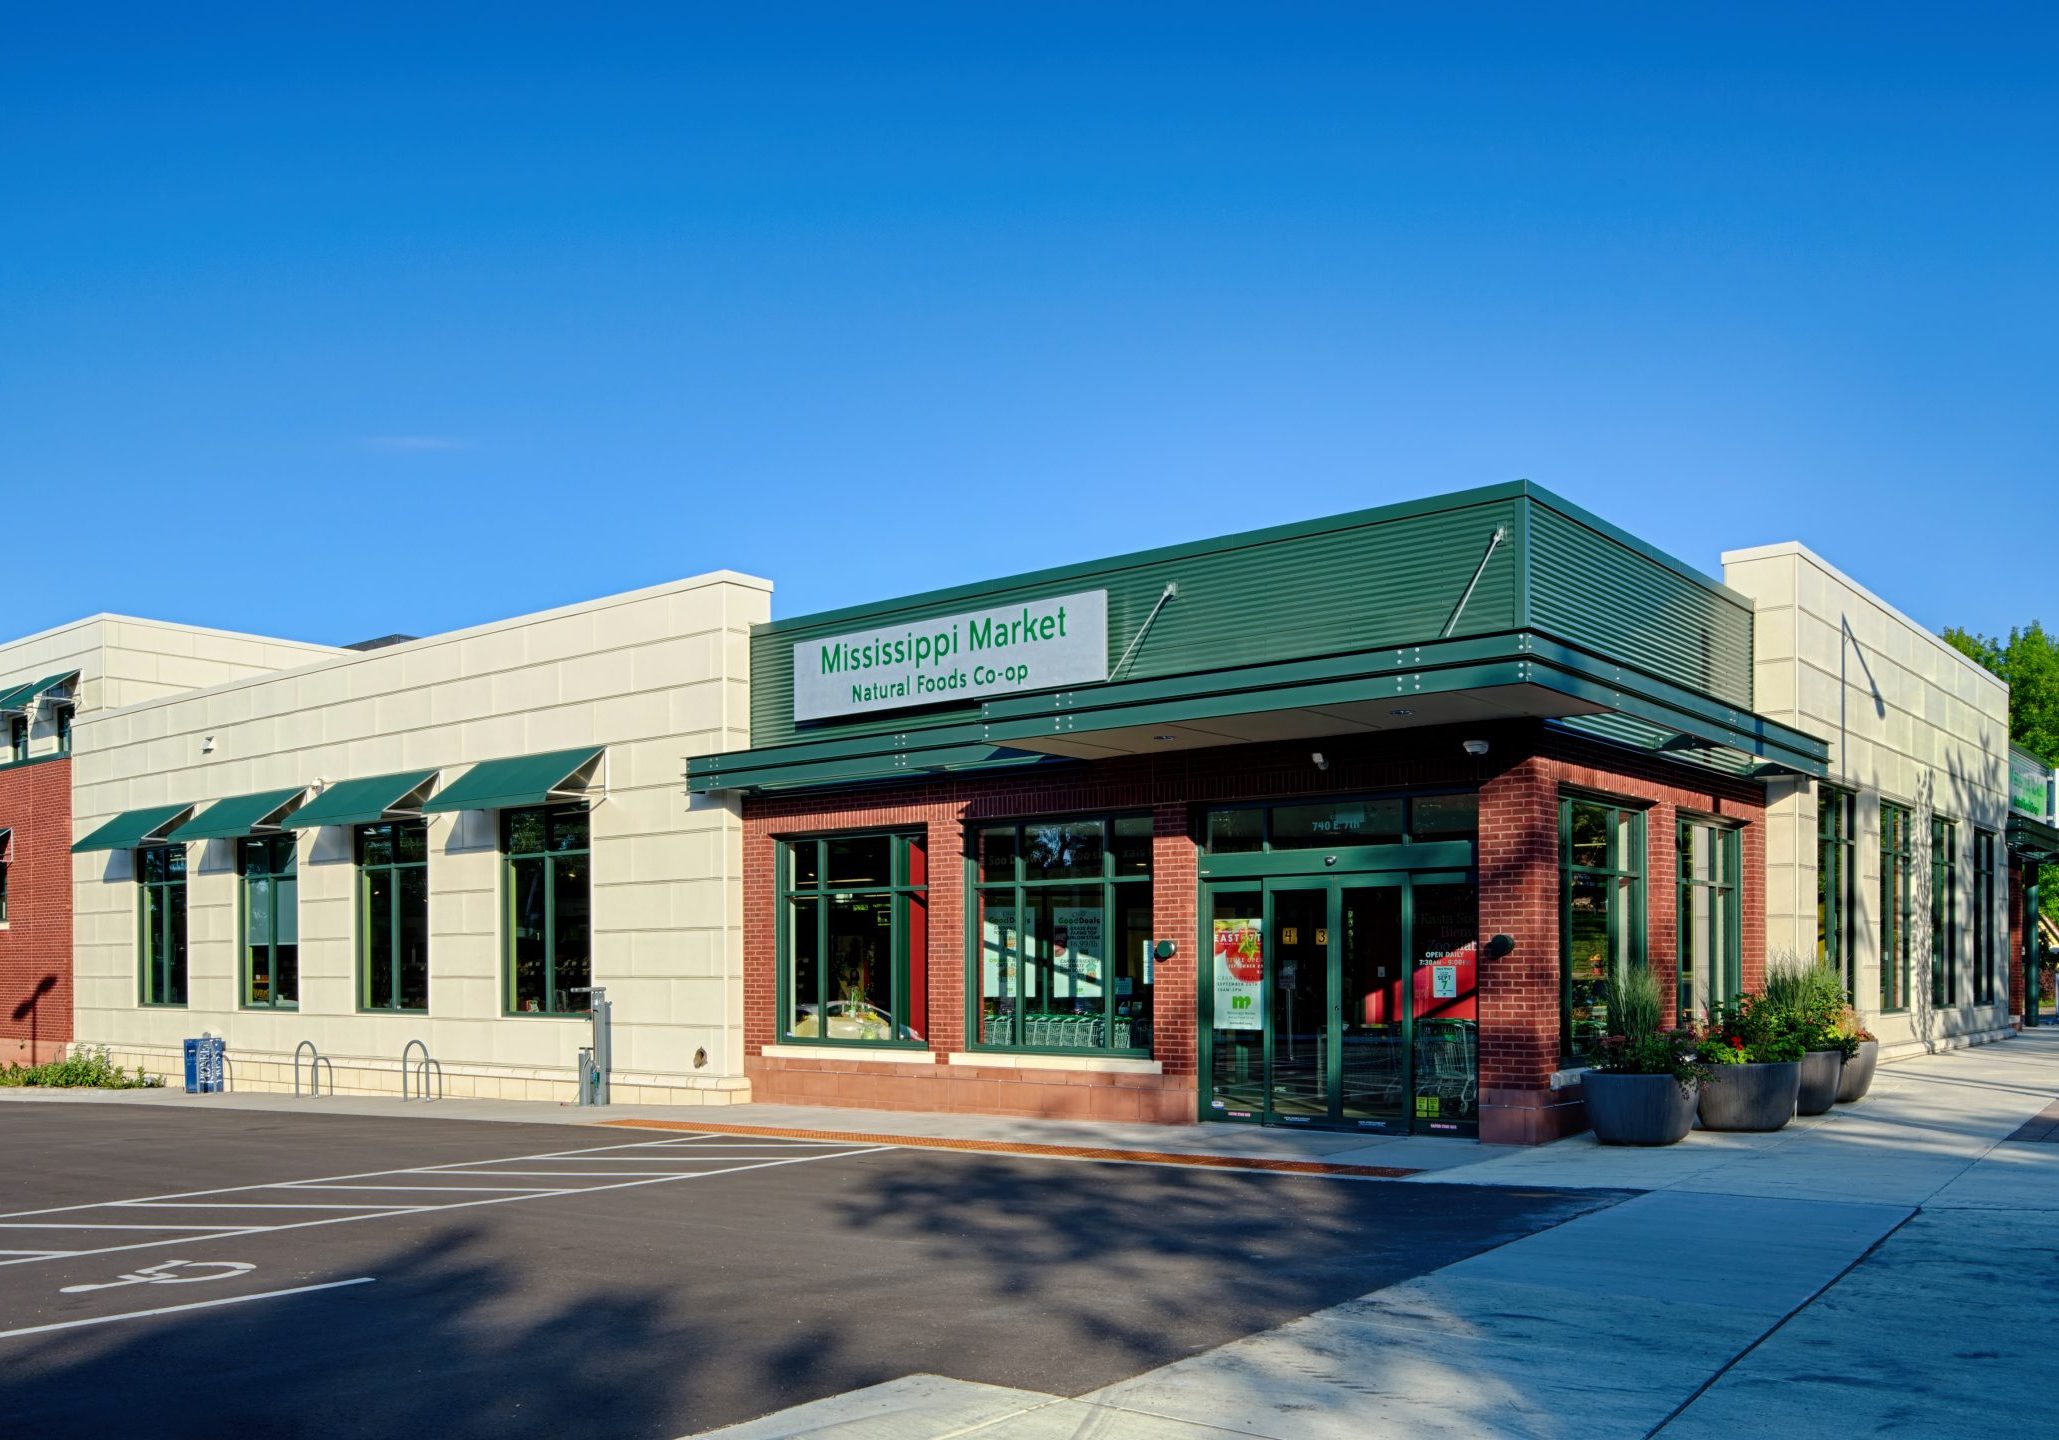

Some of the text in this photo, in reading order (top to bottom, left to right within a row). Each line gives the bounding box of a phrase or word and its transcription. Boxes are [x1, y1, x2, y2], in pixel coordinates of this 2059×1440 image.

[821, 606, 1067, 674] Mississippi Market
[852, 663, 1029, 703] Natural Foods Co-op
[1311, 821, 1331, 831] 740
[1214, 933, 1239, 943] EAST
[1285, 929, 1293, 943] 4
[1318, 929, 1326, 943] 3
[1425, 951, 1443, 959] OPEN
